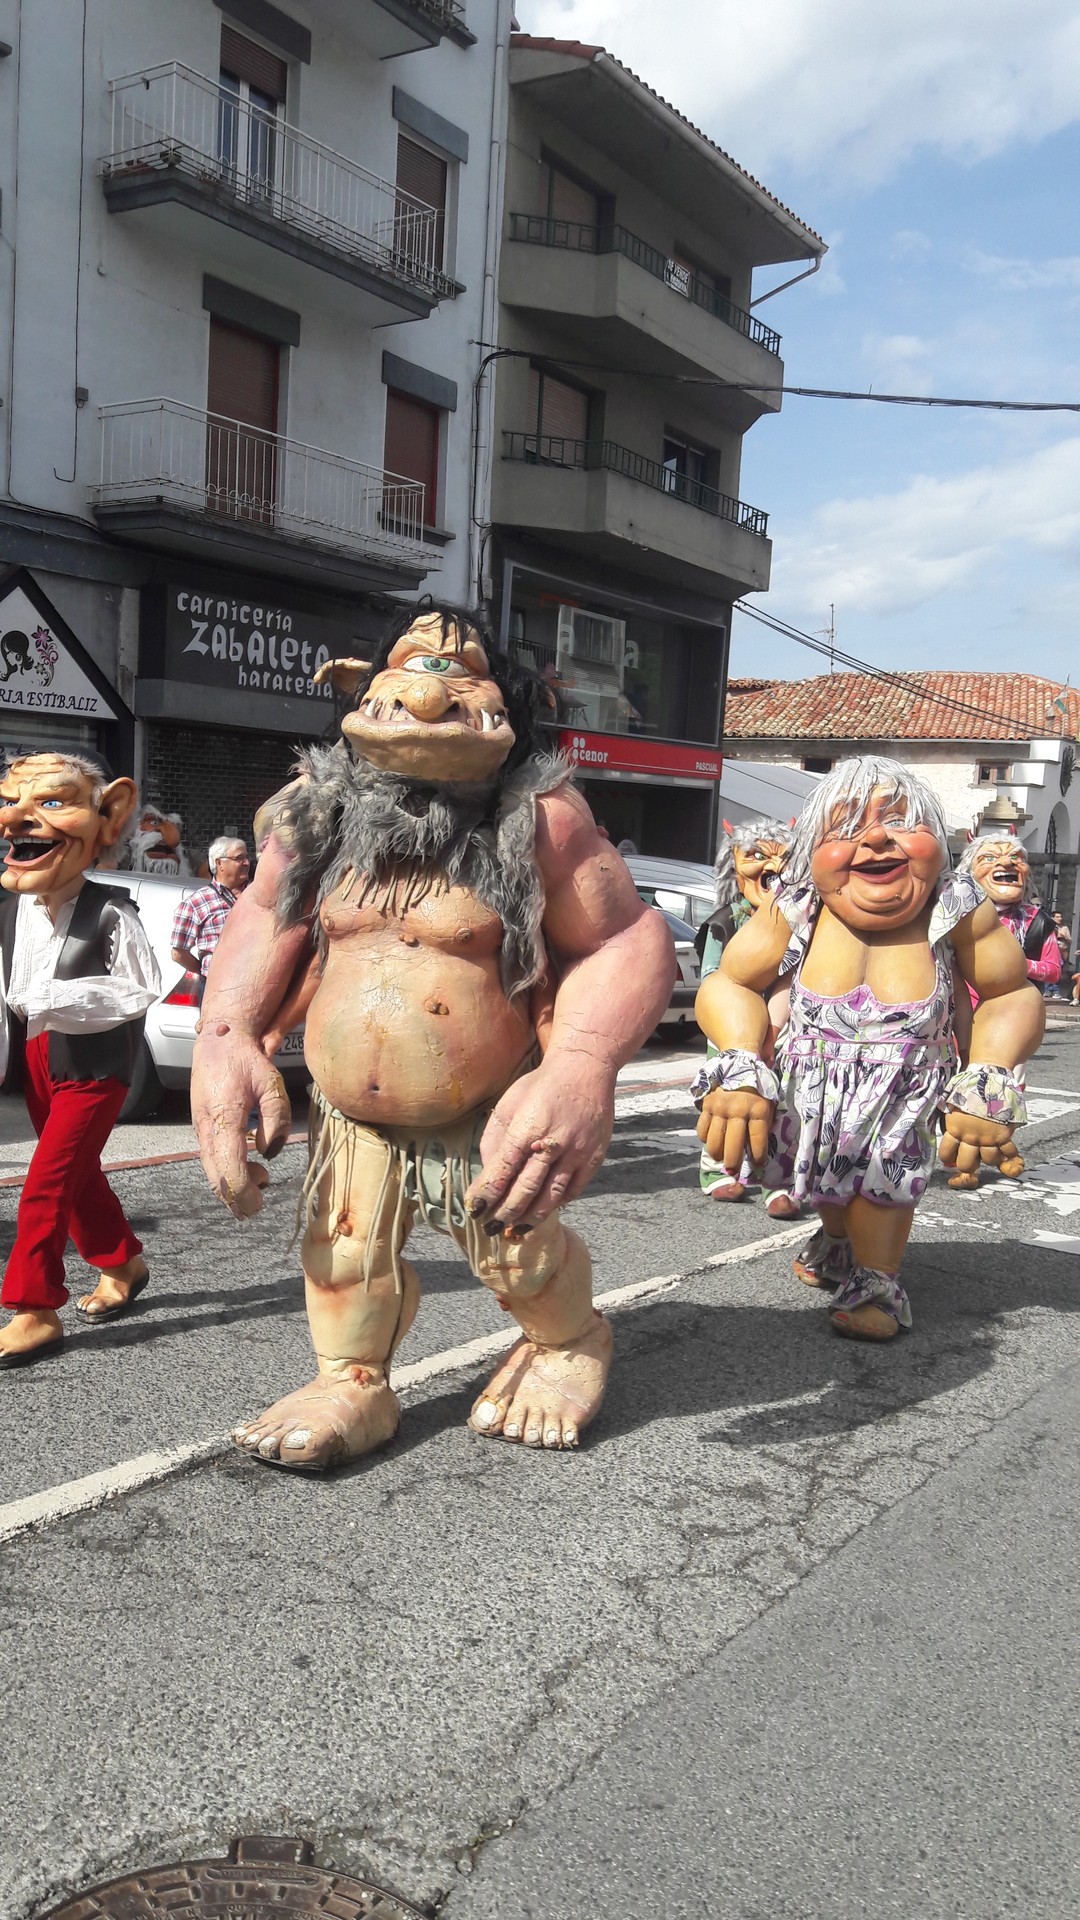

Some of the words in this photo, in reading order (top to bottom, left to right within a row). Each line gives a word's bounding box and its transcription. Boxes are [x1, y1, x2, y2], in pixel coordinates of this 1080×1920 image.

[177, 592, 292, 632] carnicería
[27, 691, 98, 712] ESTIBALIZ
[579, 749, 608, 763] cenor
[695, 761, 718, 773] PASCUAL
